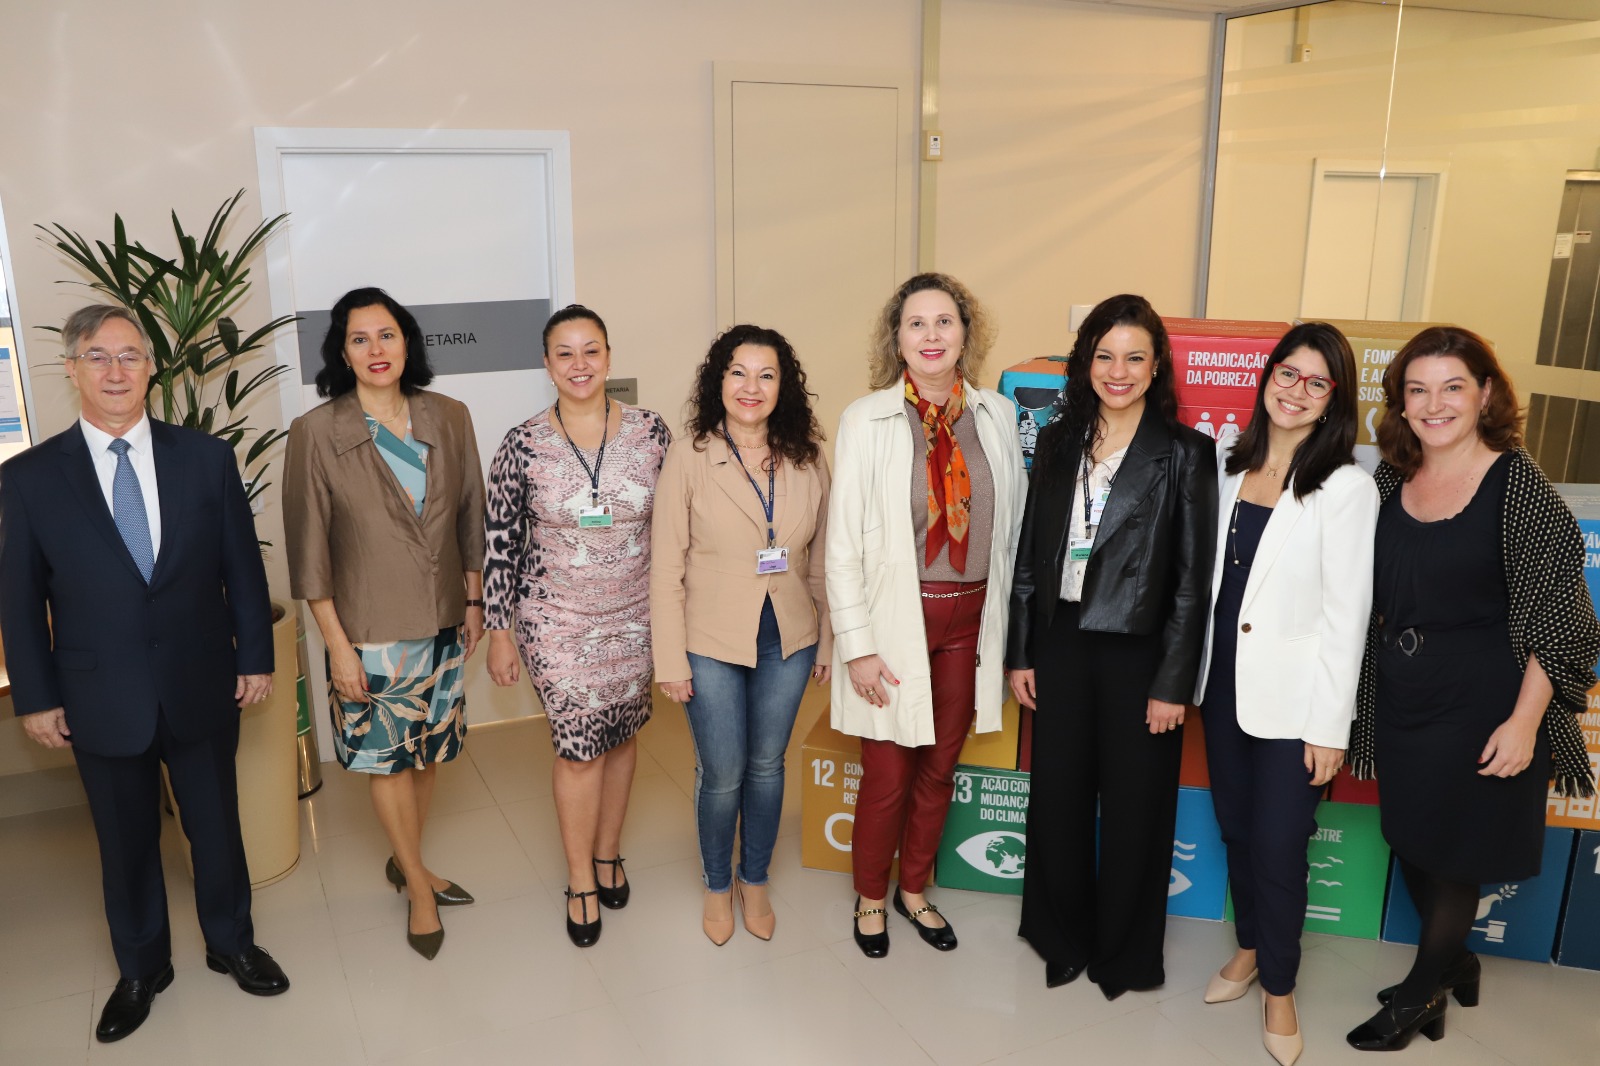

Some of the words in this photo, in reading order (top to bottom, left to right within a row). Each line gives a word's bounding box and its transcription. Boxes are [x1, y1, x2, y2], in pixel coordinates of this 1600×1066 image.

[425, 332, 477, 347] ETARIA
[1187, 351, 1270, 370] ERRADICAÇÃO
[1186, 369, 1203, 385] DA
[1203, 370, 1257, 388] POBREZA
[1360, 367, 1370, 383] E
[1358, 386, 1389, 402] SUS
[811, 758, 836, 787] 12
[843, 762, 864, 776] CON
[980, 792, 1030, 810] MUDANÇA
[980, 807, 995, 821] DO
[995, 809, 1027, 824] CLIMA
